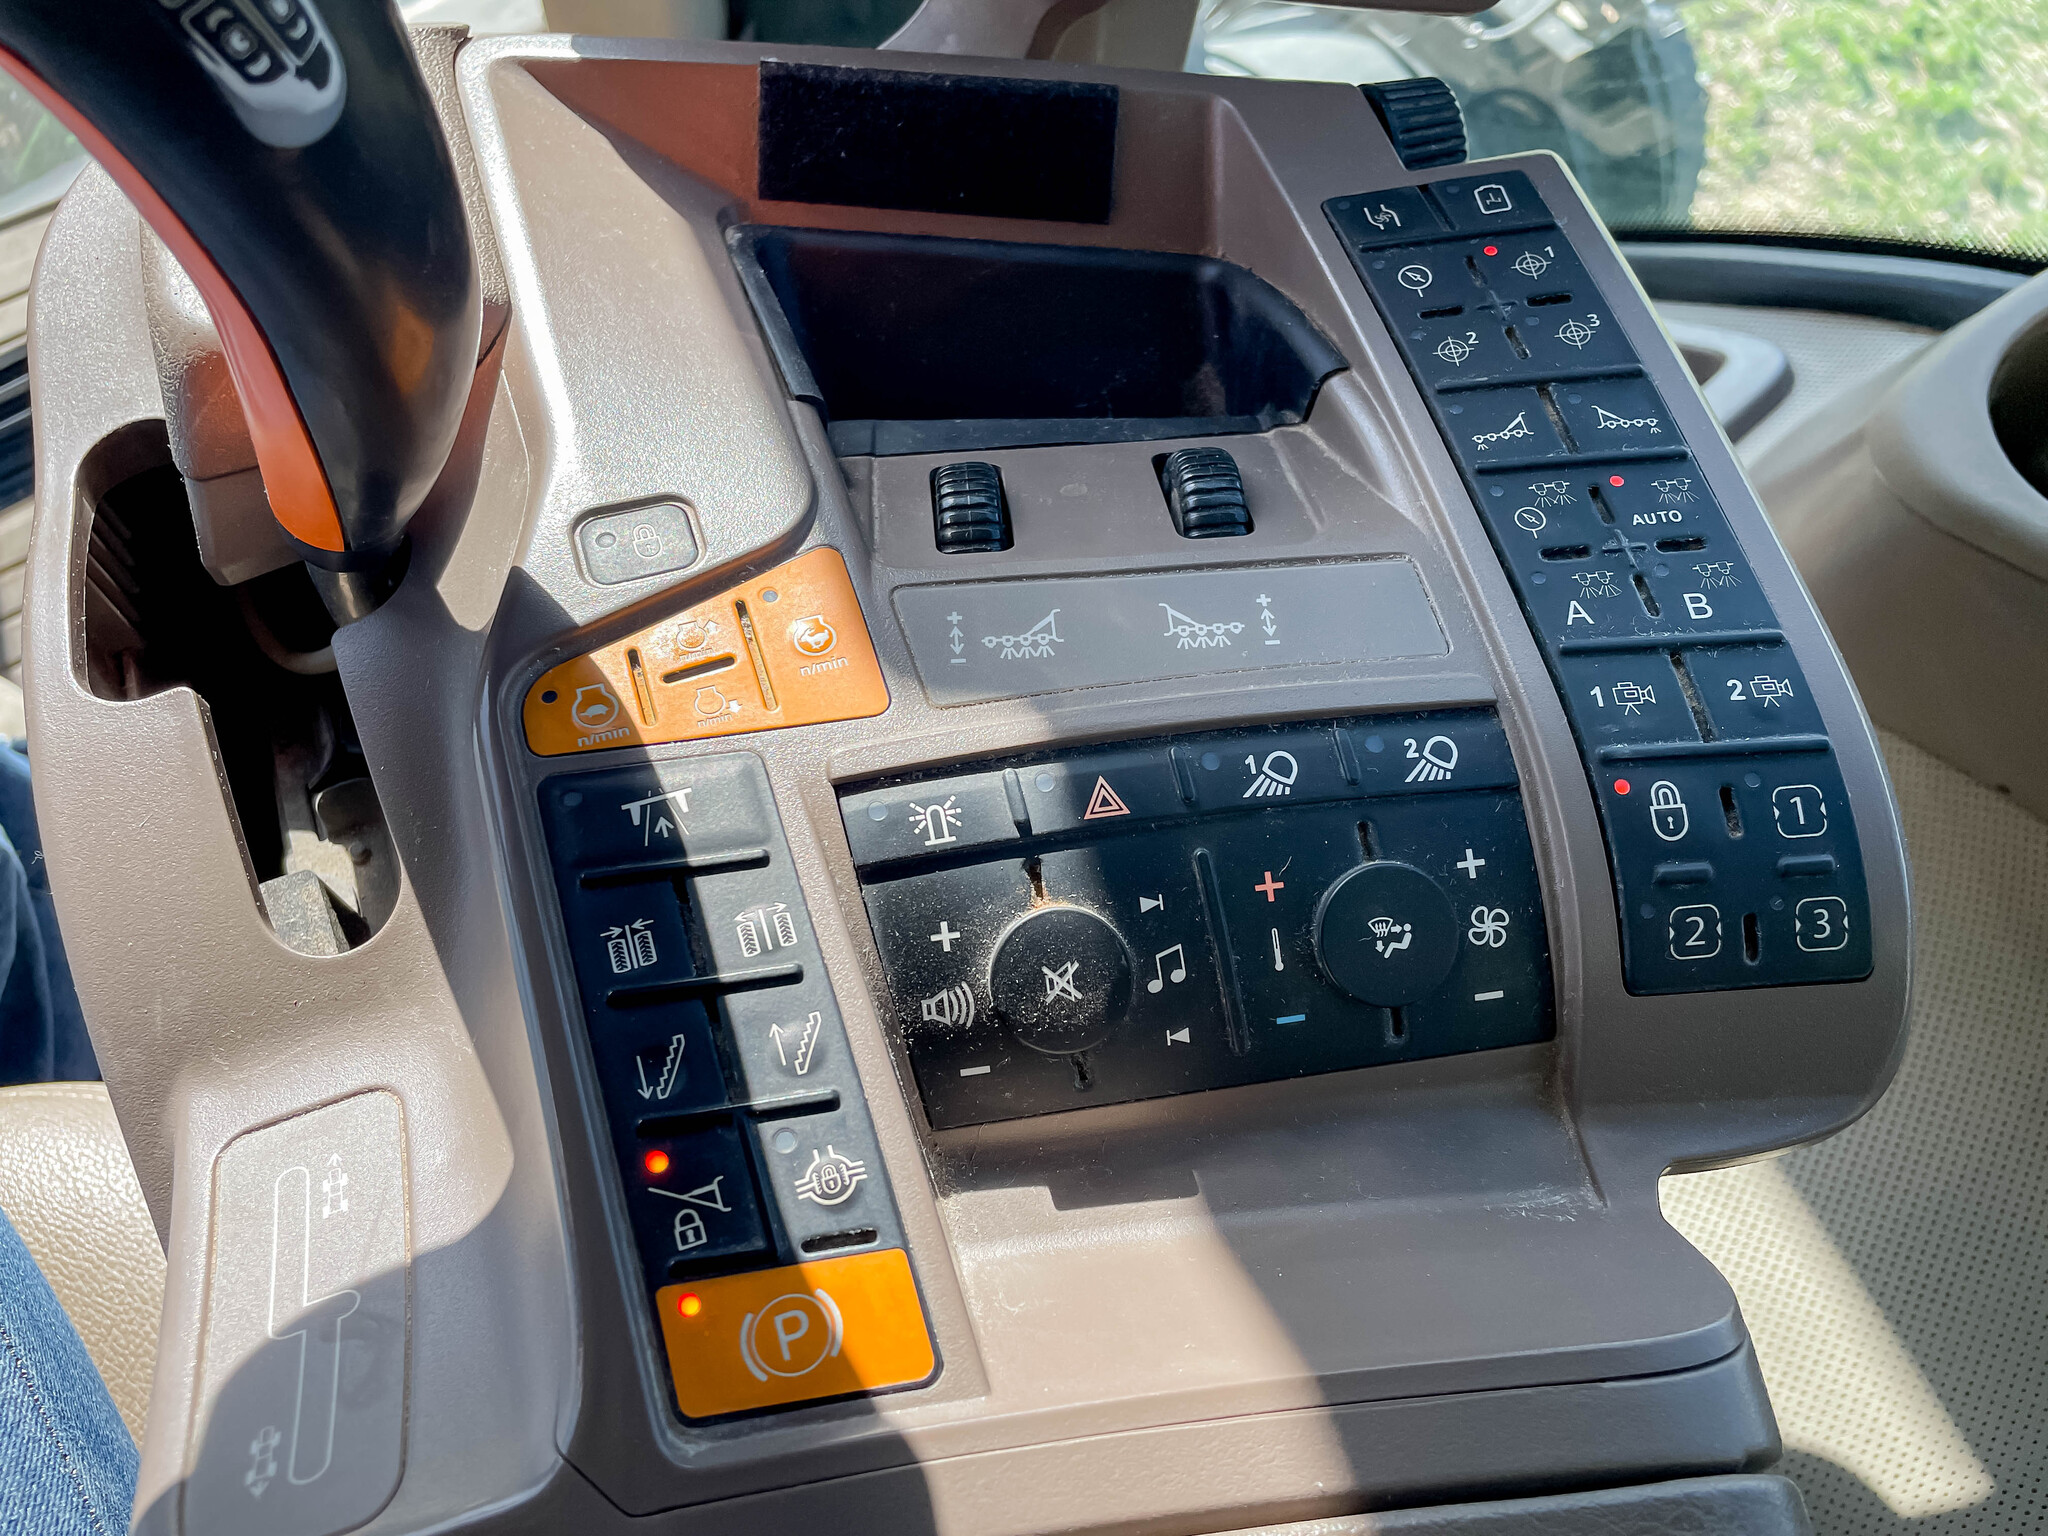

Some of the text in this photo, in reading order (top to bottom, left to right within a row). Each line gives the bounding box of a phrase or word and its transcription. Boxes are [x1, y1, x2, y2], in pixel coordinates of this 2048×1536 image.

[1587, 313, 1600, 327] 3
[1466, 332, 1479, 345] 2
[1632, 509, 1683, 527] AUTO
[1566, 599, 1596, 626] A
[1683, 593, 1714, 620] B
[800, 653, 849, 677] n/min
[1590, 686, 1605, 708] 1
[1726, 679, 1747, 701] 2
[697, 712, 733, 728] n/min
[577, 724, 630, 748] n/min
[1403, 736, 1420, 760] 2
[1243, 753, 1257, 775] 1
[1789, 796, 1807, 825] 1
[1685, 915, 1707, 947] 2
[1813, 908, 1832, 940] 3
[774, 1309, 811, 1362] P
